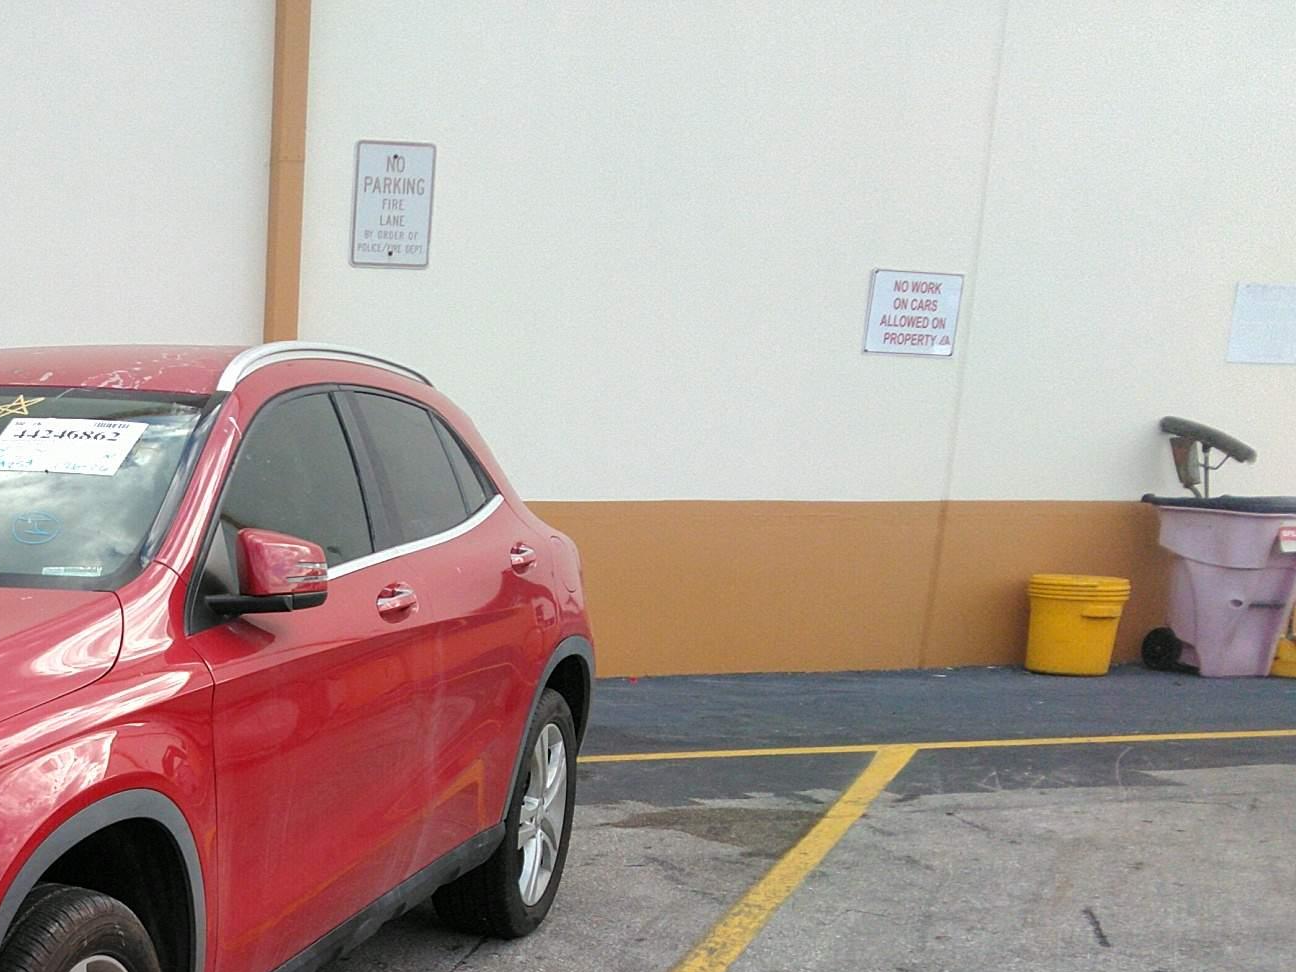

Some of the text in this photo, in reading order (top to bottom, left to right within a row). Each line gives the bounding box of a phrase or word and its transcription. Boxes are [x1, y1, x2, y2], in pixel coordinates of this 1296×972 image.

[386, 155, 406, 173] NO
[363, 176, 425, 195] PARKING
[382, 199, 405, 211] FIRE
[380, 215, 405, 227] LANE
[894, 280, 943, 294] NO WORK
[893, 298, 938, 312] ON CARS
[880, 315, 946, 329] ALLOWED ON
[883, 333, 937, 346] PROPERTY
[13, 429, 122, 442] 44246862
